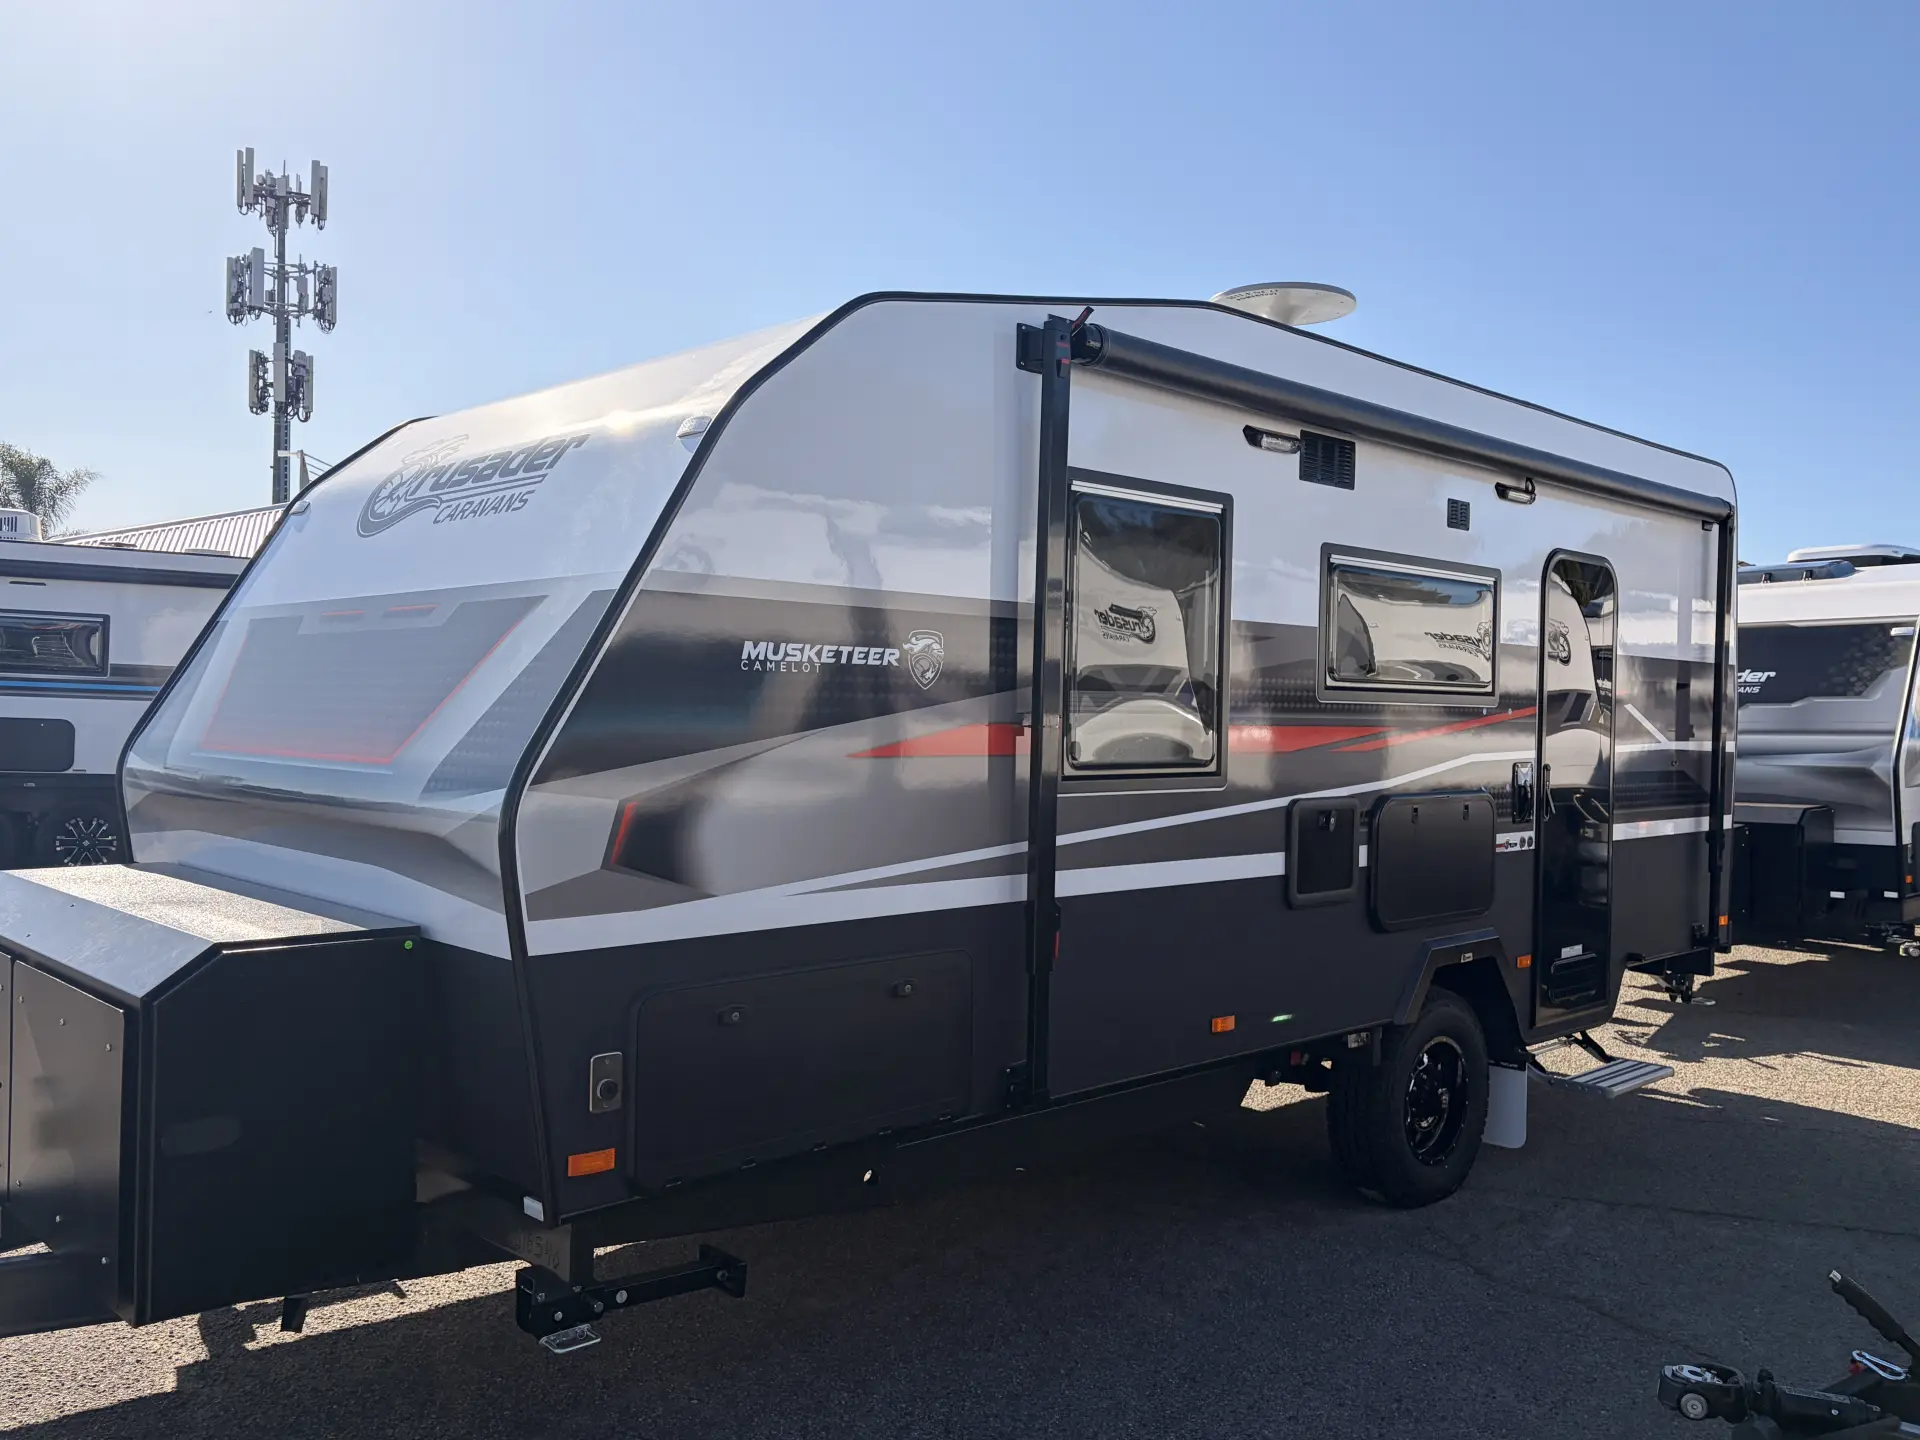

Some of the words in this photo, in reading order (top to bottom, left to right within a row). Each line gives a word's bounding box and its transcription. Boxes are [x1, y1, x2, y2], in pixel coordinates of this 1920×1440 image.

[356, 433, 591, 538] Crusader
[432, 489, 536, 525] CARAVANS
[740, 660, 822, 674] CAMELOT
[741, 640, 901, 667] MUSKETEER
[1737, 686, 1761, 694] ANS
